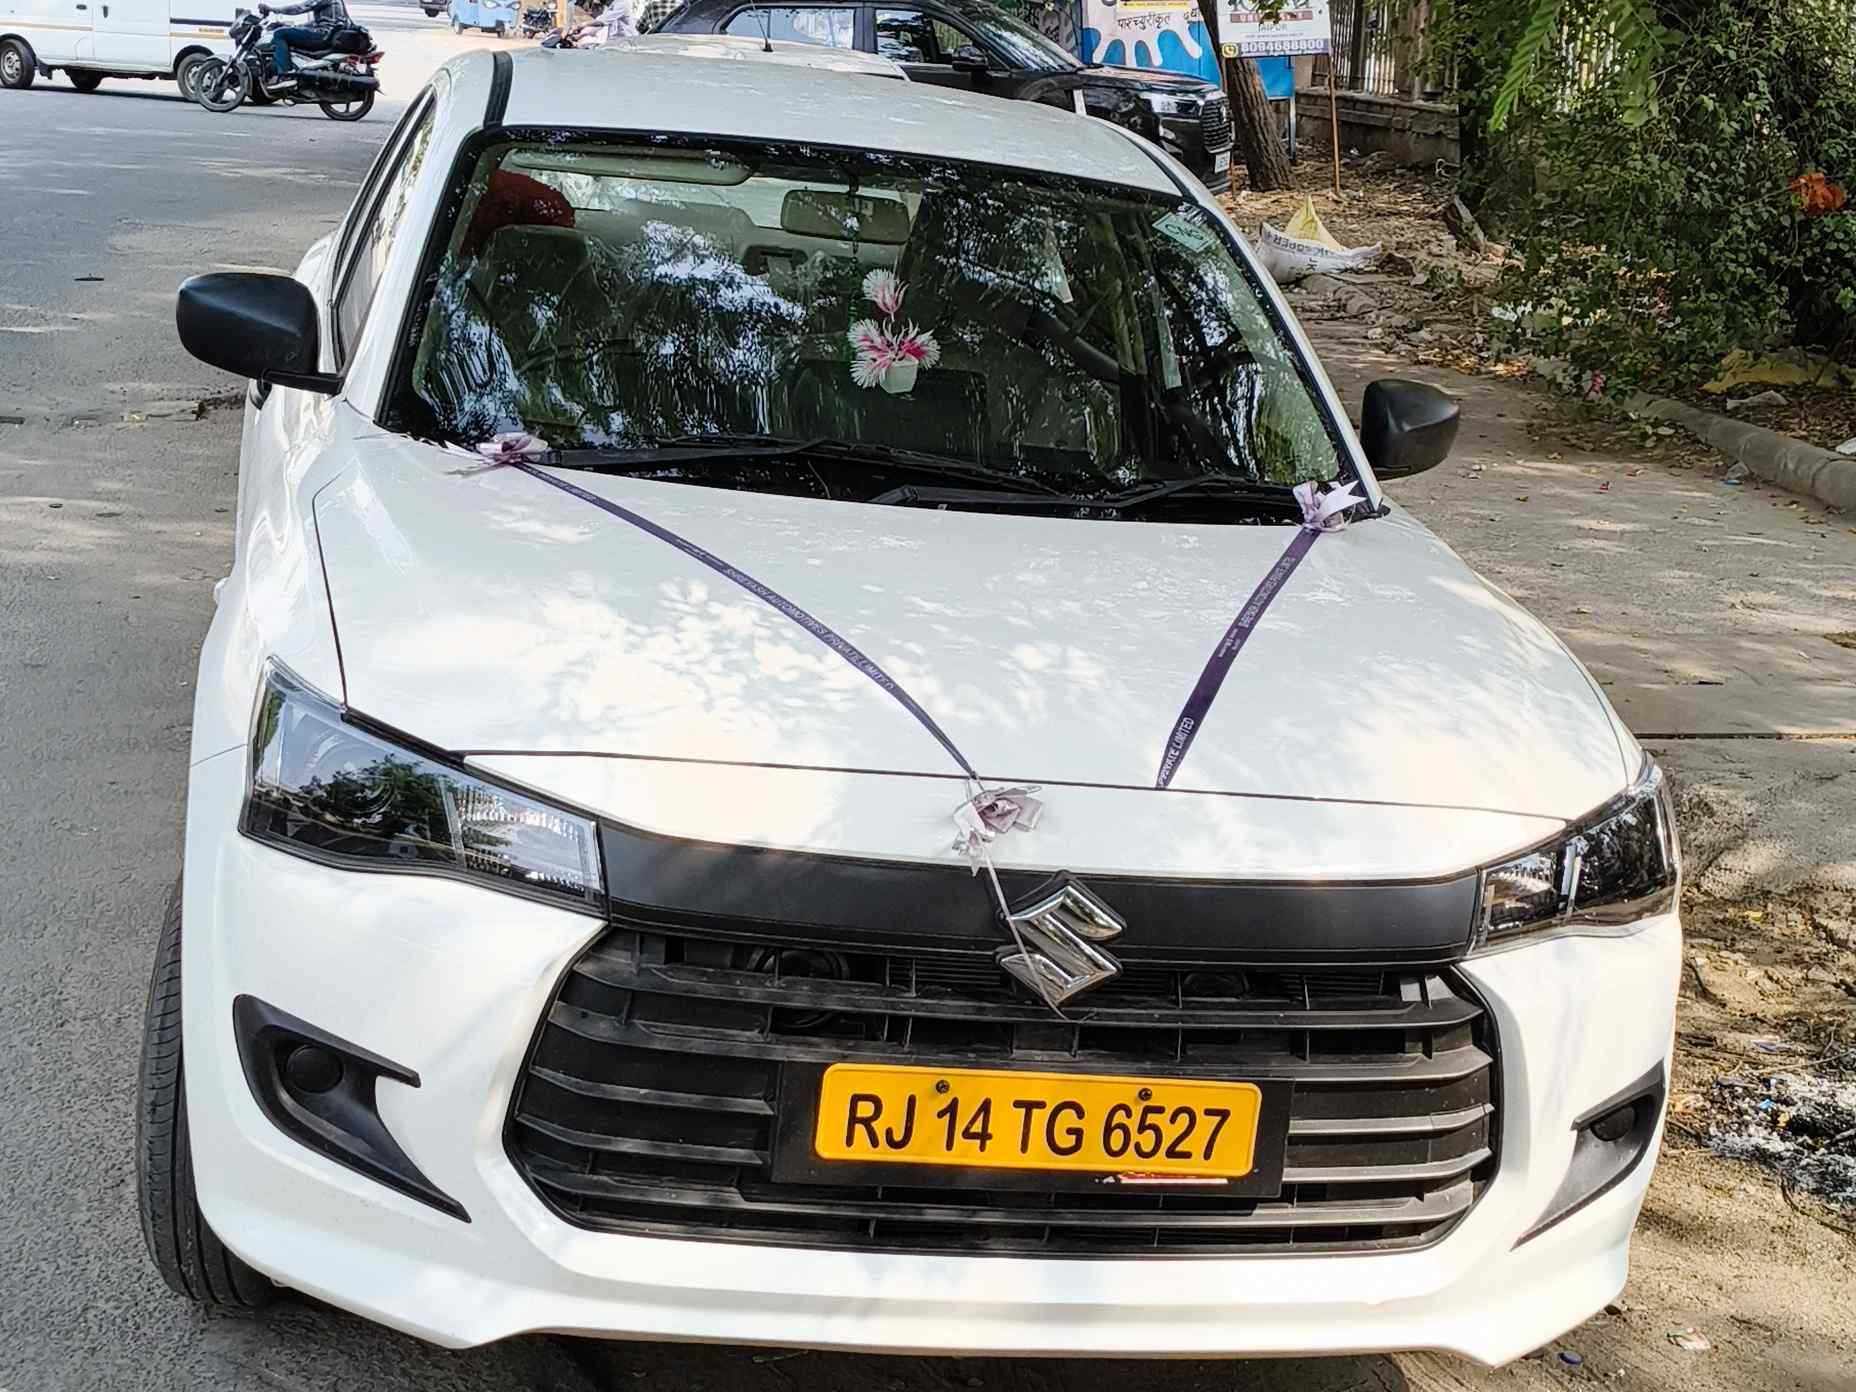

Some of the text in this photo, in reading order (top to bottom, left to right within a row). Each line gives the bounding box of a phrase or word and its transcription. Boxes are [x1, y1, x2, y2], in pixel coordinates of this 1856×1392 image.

[1164, 222, 1204, 241] CNG
[1172, 717, 1195, 750] LIMITED
[846, 1094, 1231, 1161] RJ 14 TG 6527
